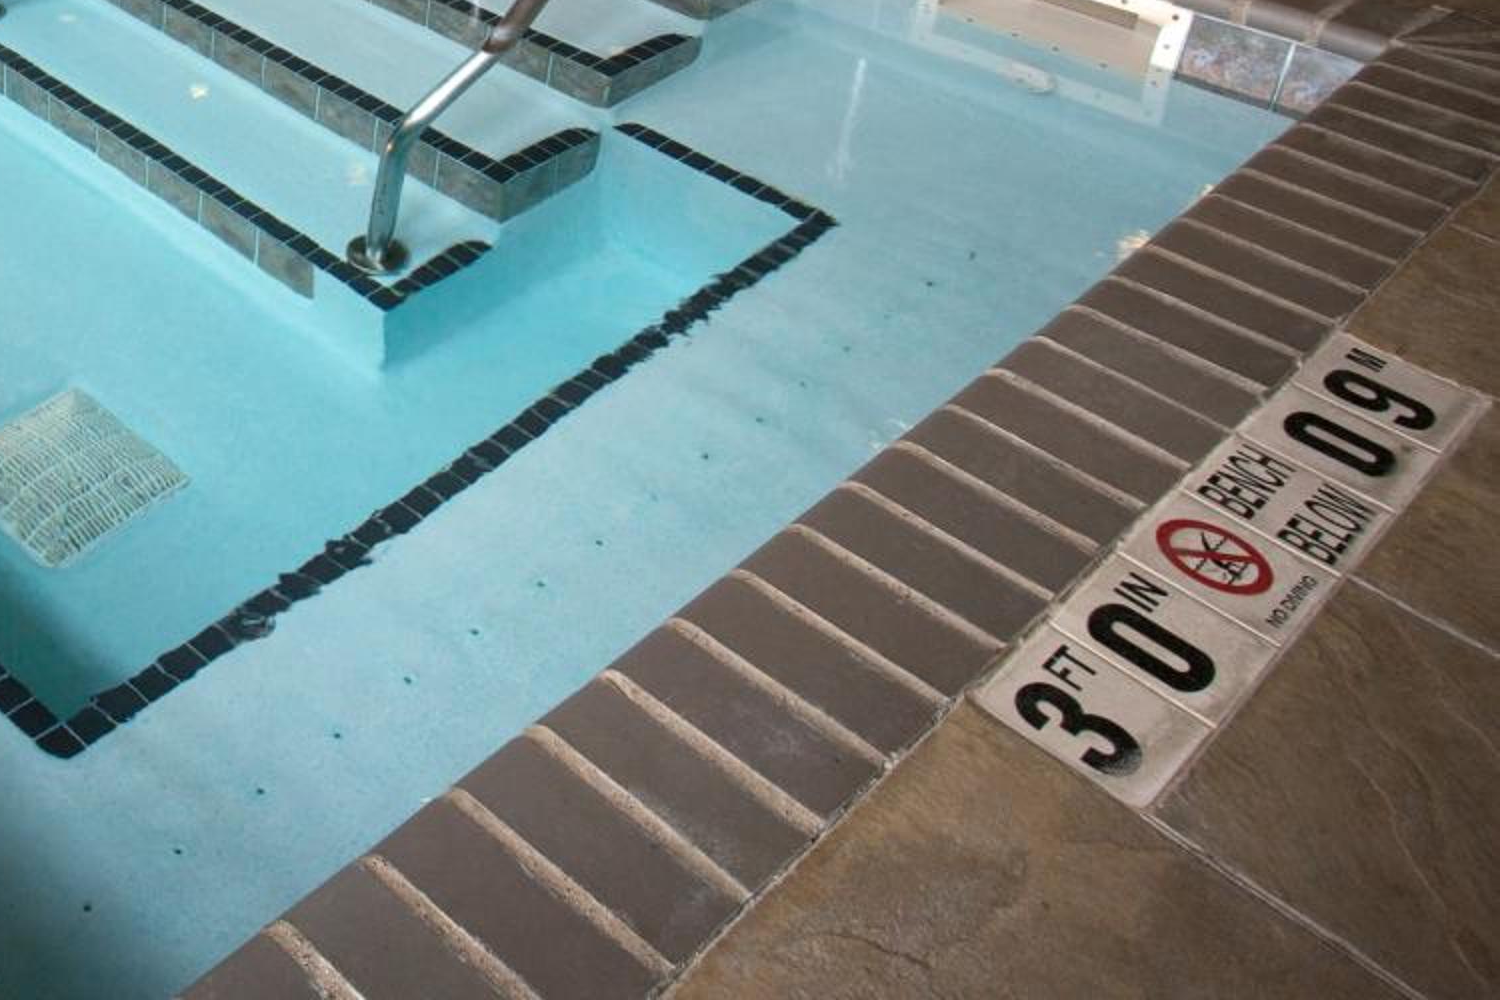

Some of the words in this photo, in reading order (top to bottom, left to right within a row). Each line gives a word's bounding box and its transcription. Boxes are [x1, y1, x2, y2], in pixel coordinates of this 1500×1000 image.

[1196, 443, 1298, 522] BENCH
[1276, 483, 1381, 566] BELOW
[1264, 607, 1289, 629] NO
[1279, 575, 1319, 612] DIVING
